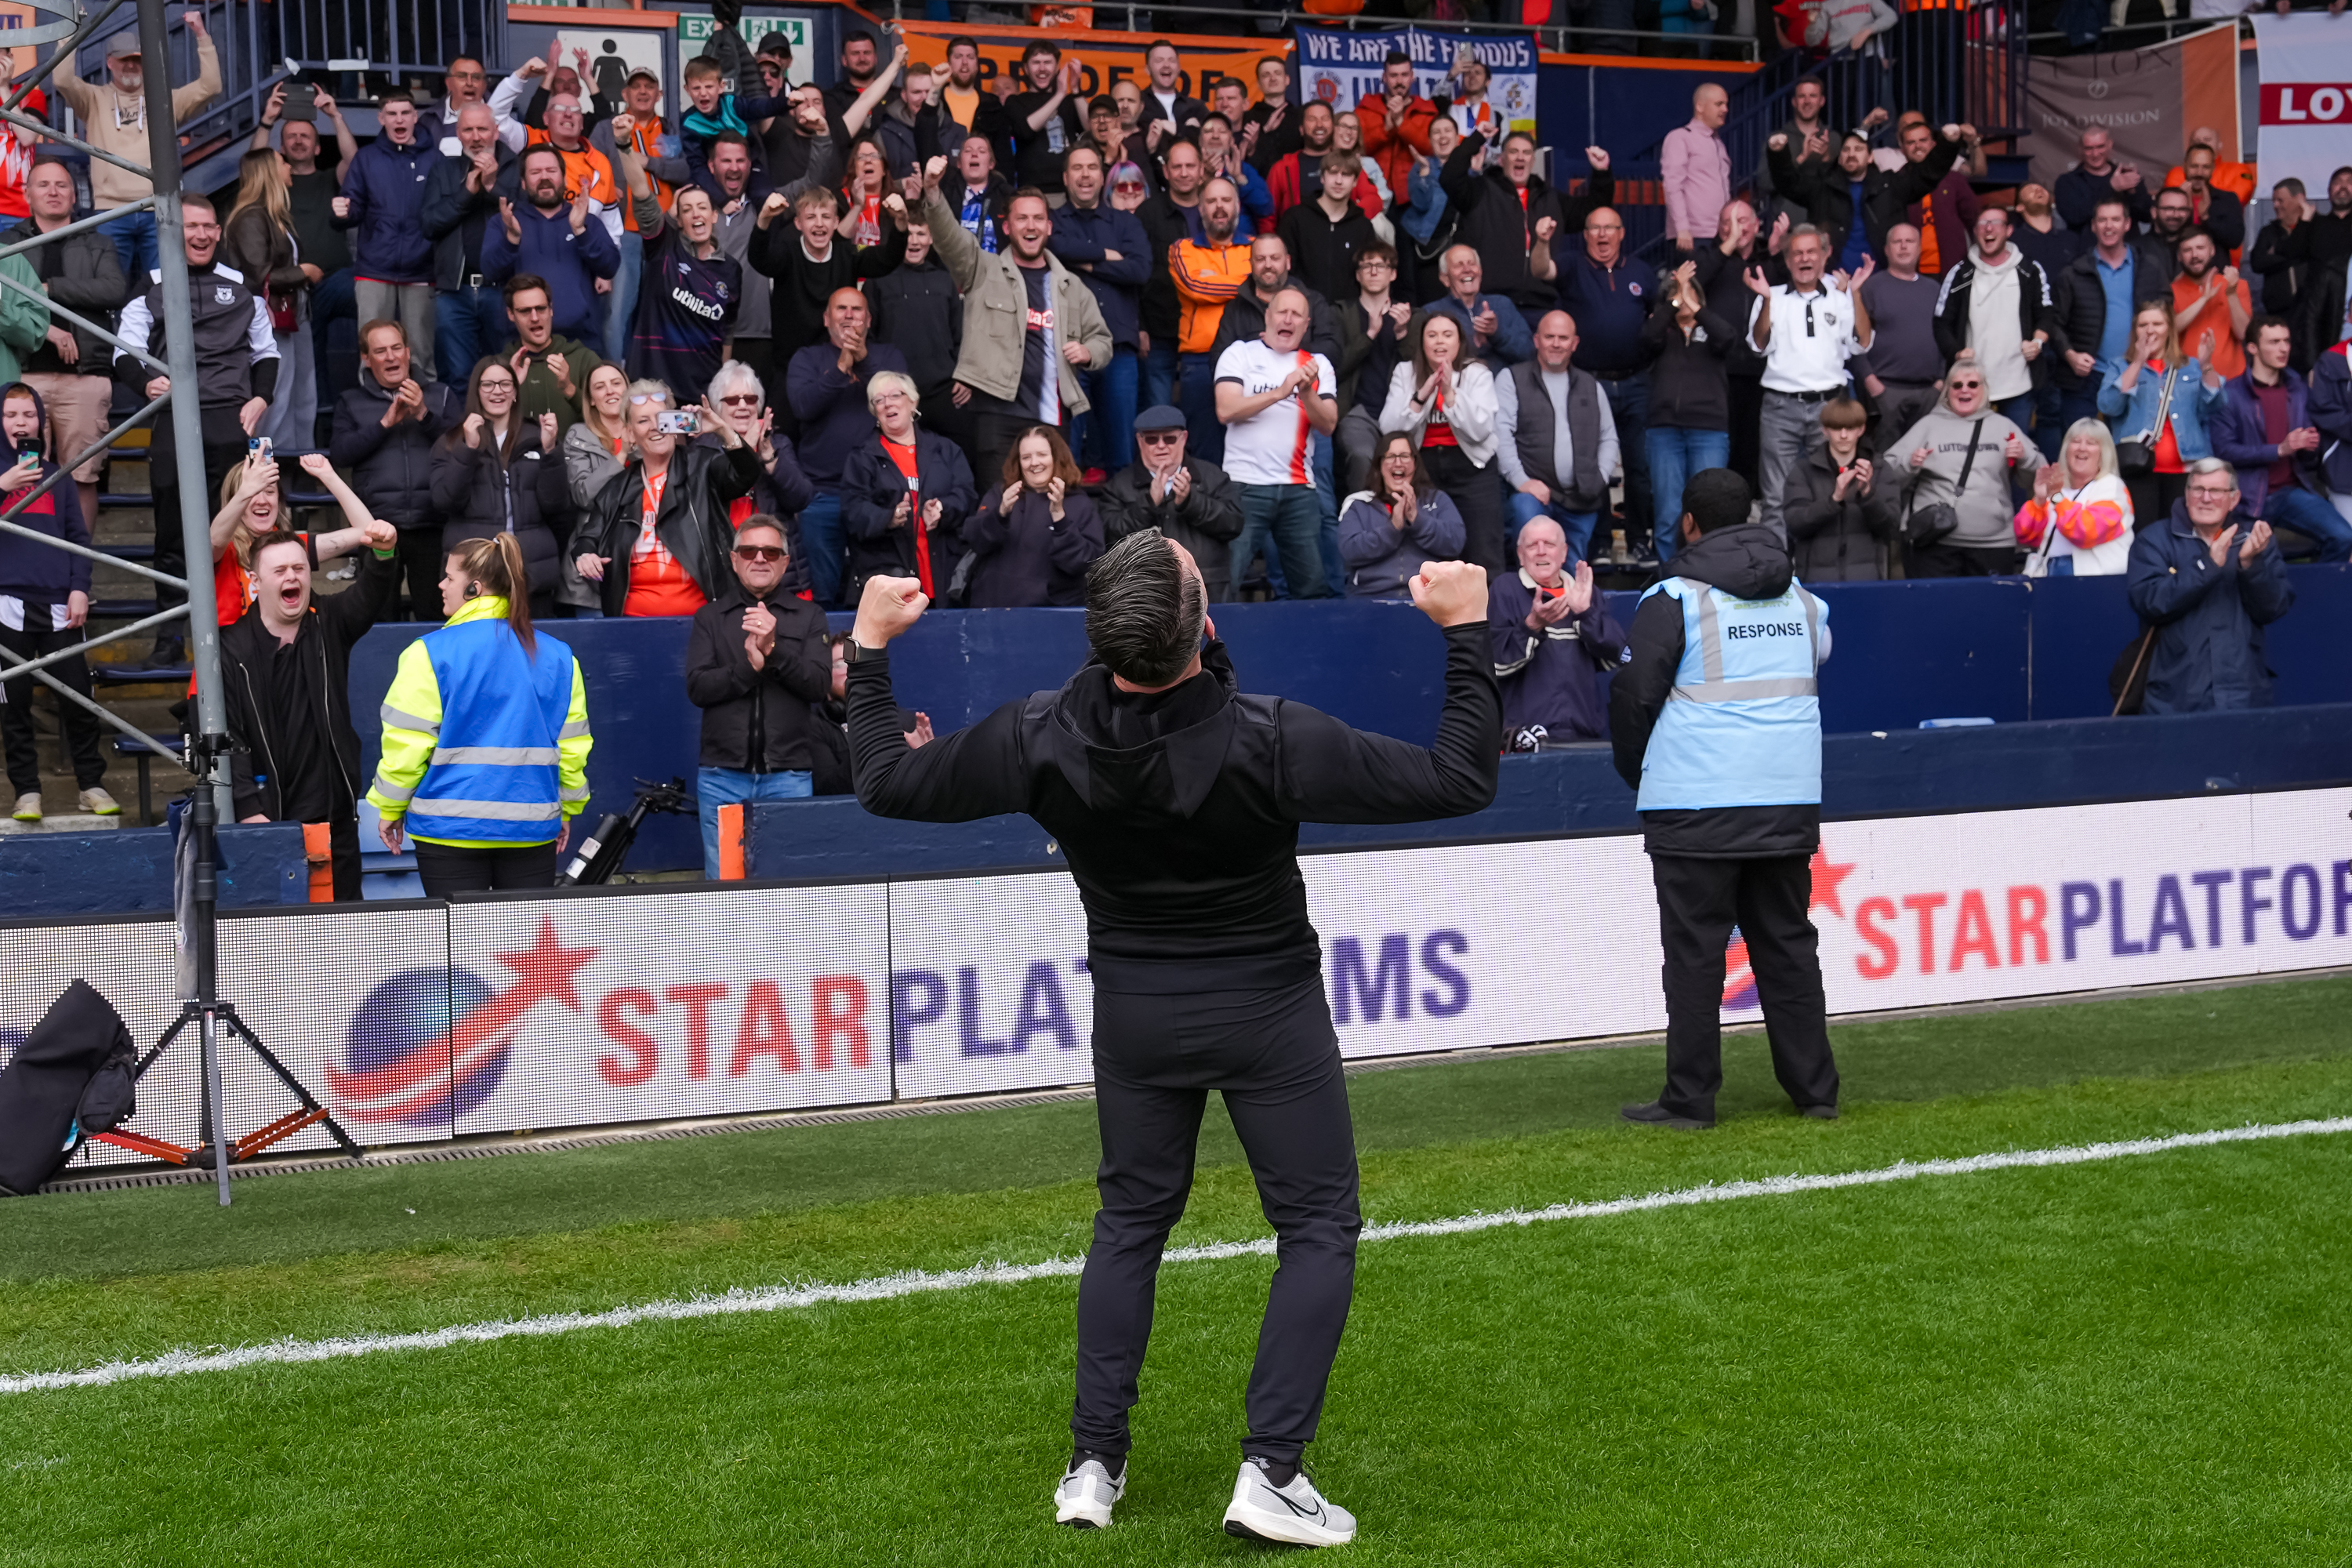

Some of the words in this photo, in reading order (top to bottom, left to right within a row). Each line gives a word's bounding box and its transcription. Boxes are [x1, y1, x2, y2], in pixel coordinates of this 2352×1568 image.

[687, 20, 713, 38] EX
[1305, 33, 1343, 60] WE
[1348, 38, 1392, 62] ARE
[1394, 32, 1436, 63] THE
[2279, 87, 2352, 121] LO
[2074, 108, 2160, 127] DIVISION
[672, 287, 713, 318] utilita
[1728, 622, 1804, 640] RESPONSE
